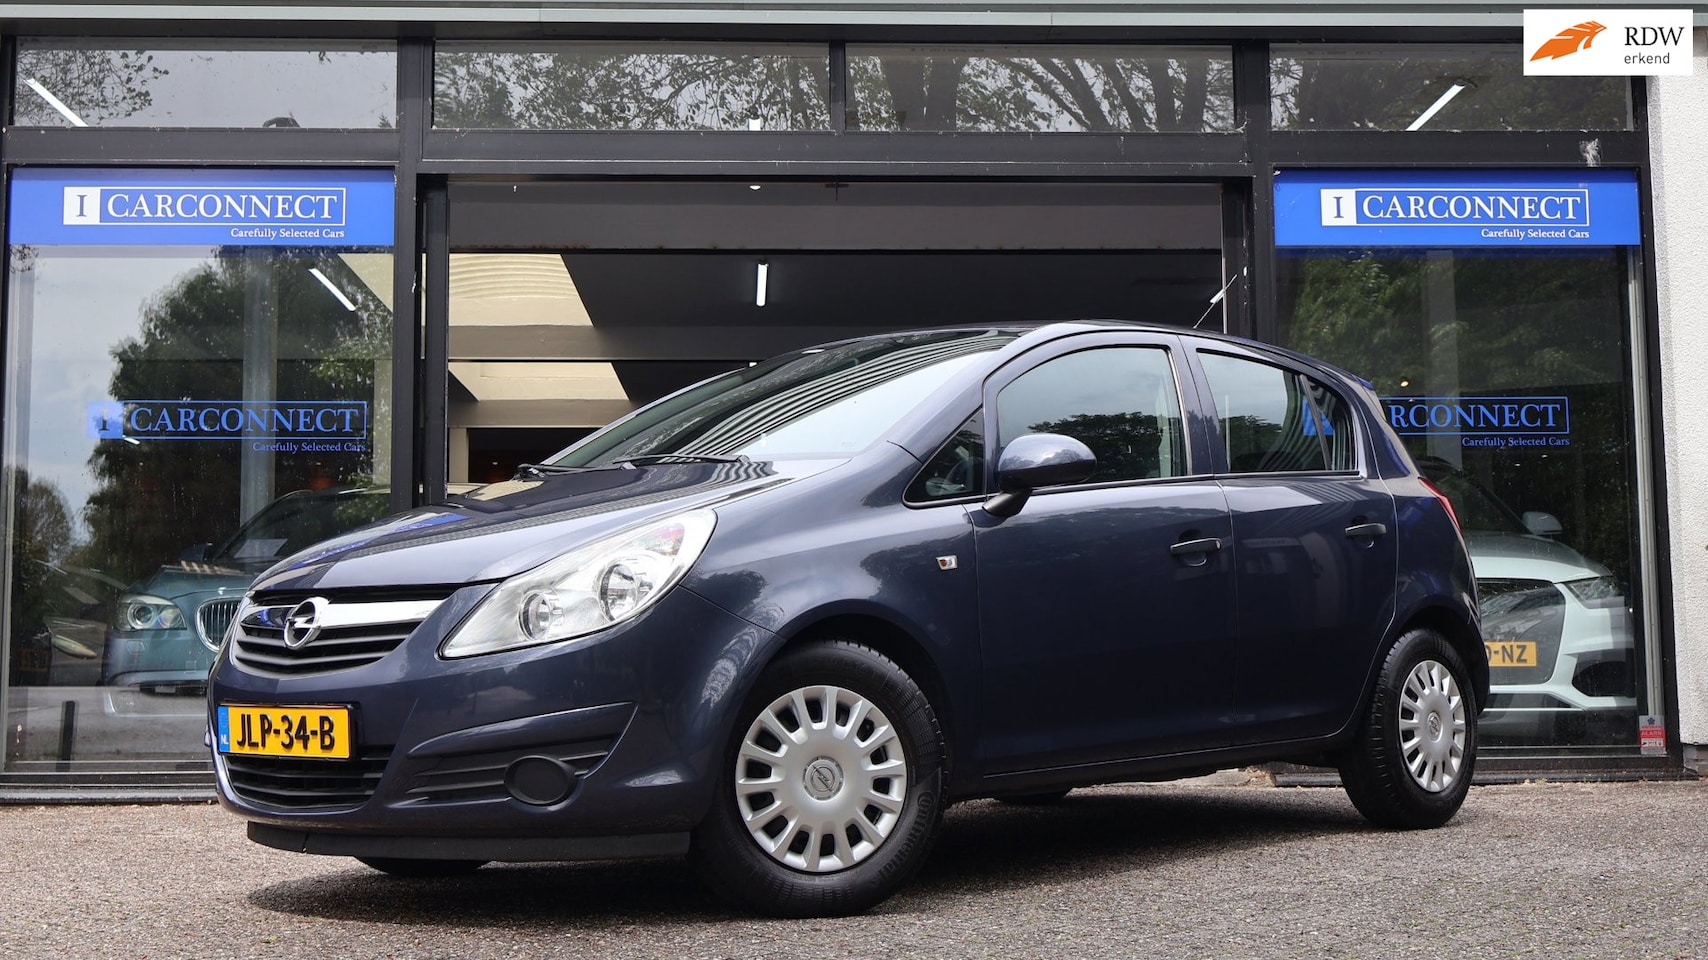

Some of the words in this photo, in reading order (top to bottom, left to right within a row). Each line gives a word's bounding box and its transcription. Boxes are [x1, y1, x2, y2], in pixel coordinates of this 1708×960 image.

[75, 194, 89, 218] I
[107, 193, 338, 219] CARCONNECT
[1332, 196, 1345, 219] I
[1362, 195, 1581, 220] CARCONNECT
[230, 227, 277, 240] Carefully
[279, 227, 320, 239] Selected
[322, 228, 345, 239] Cars
[1481, 228, 1525, 241] Carefully
[1527, 228, 1566, 239] Selected
[1568, 228, 1590, 239] Cars
[130, 406, 359, 433] CARCONNECT
[1388, 403, 1561, 429] RCONNECT
[252, 441, 298, 454] Carefully
[301, 441, 341, 452] Selected
[344, 442, 366, 452] Cars
[1461, 436, 1506, 449] Carefully
[1508, 436, 1547, 447] Selected
[1549, 437, 1570, 447] Cars
[220, 734, 229, 744] NL
[236, 713, 336, 750] JLP-34-B
